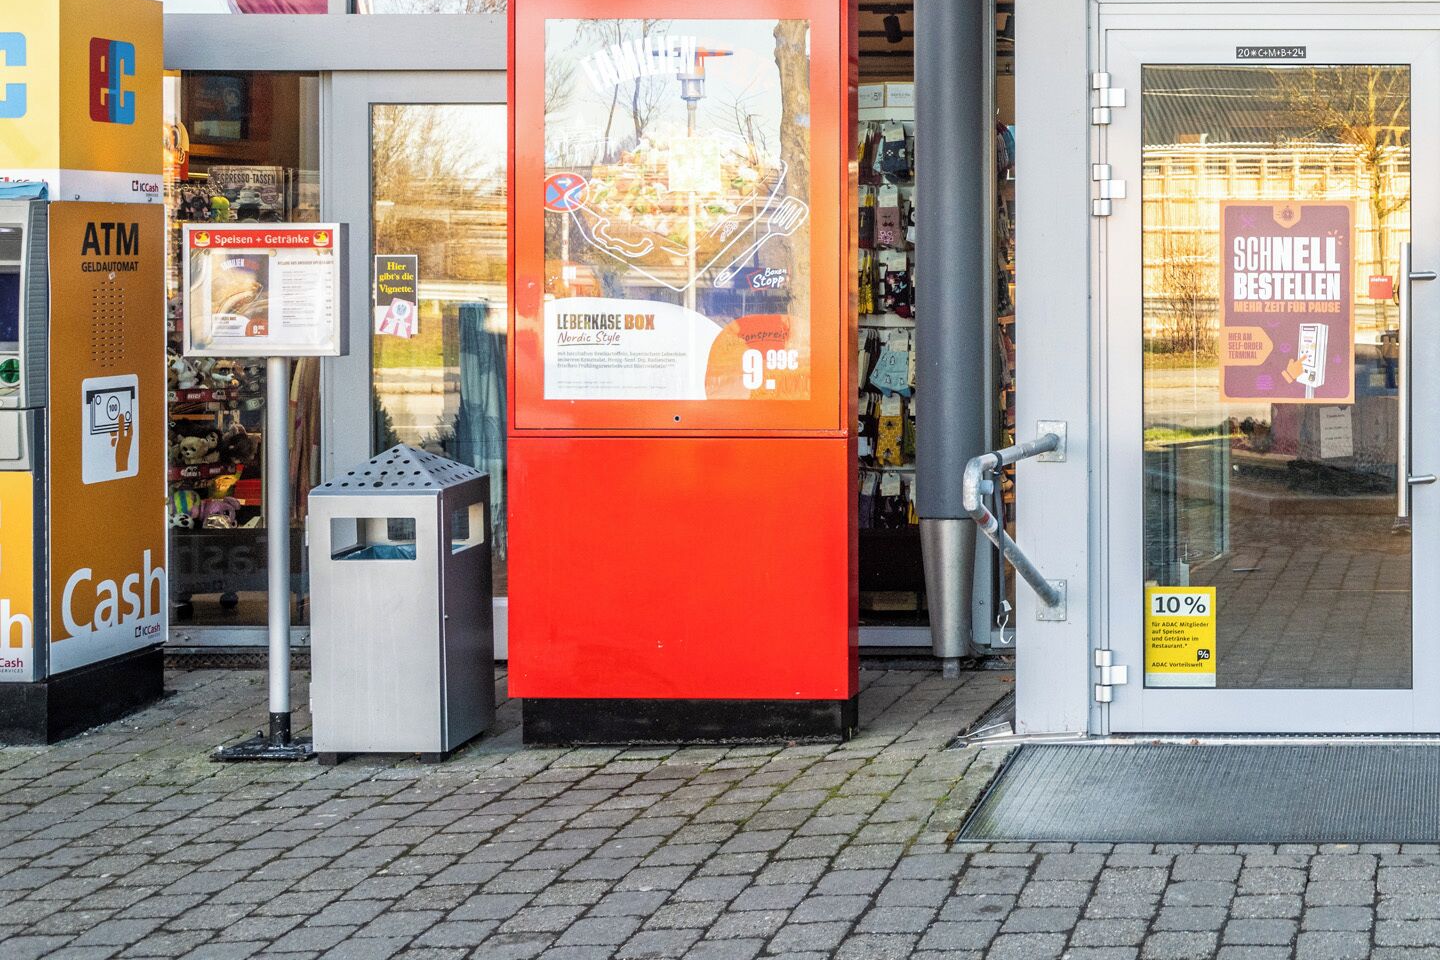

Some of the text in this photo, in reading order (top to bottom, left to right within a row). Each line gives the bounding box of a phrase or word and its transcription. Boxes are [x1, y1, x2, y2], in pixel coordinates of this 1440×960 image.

[90, 37, 135, 124] EC
[81, 222, 139, 256] ATM
[214, 234, 253, 246] Speisen
[264, 234, 310, 244] Getränke
[1234, 236, 1340, 271] SCHNELL
[81, 261, 139, 272] GELDAUTOMAT
[387, 261, 406, 270] Hier
[379, 272, 414, 282] gibt's die
[765, 267, 787, 276] Boxen
[753, 274, 785, 288] Stopp
[1234, 273, 1340, 300] BESTELLEN
[379, 283, 414, 294] Vignette.
[1234, 301, 1340, 312] MEHR ZEIT FÜR PAUSE
[624, 313, 655, 330] BOX
[557, 330, 621, 345] Nordic Style
[1228, 333, 1253, 341] HIER AM
[1228, 342, 1263, 350] SELF-ORDER
[1228, 351, 1258, 359] TERMINAL
[109, 404, 118, 412] 100
[62, 549, 166, 640] Cash
